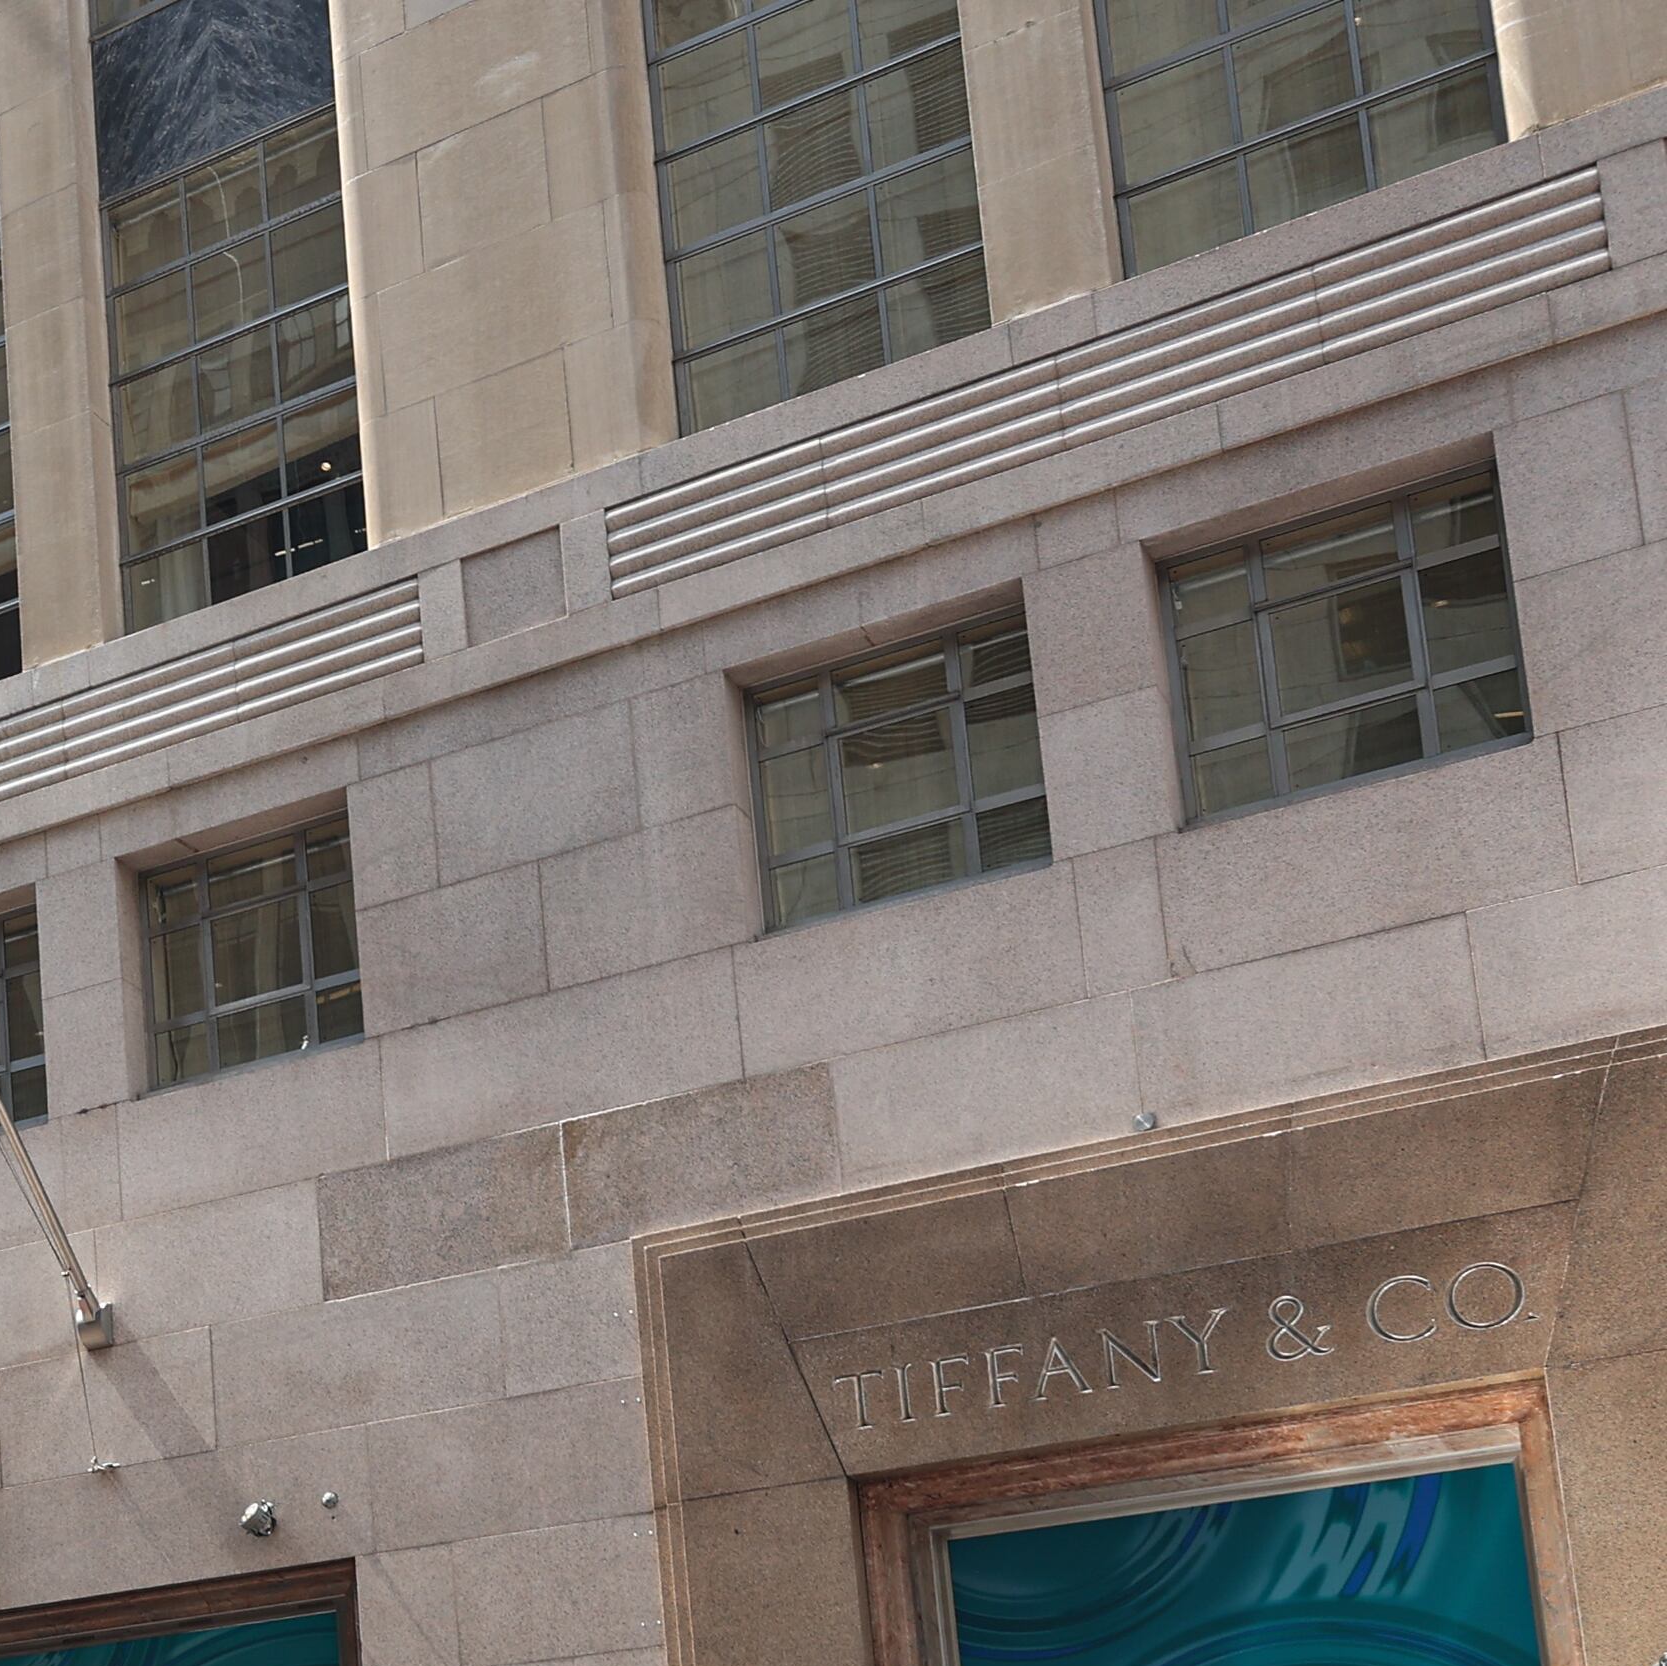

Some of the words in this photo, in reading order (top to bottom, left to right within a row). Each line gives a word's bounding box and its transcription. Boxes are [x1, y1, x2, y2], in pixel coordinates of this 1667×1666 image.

[833, 1307, 1230, 1431] TIFFANY
[1266, 1294, 1335, 1362] &
[1366, 1260, 1540, 1344] CO.
